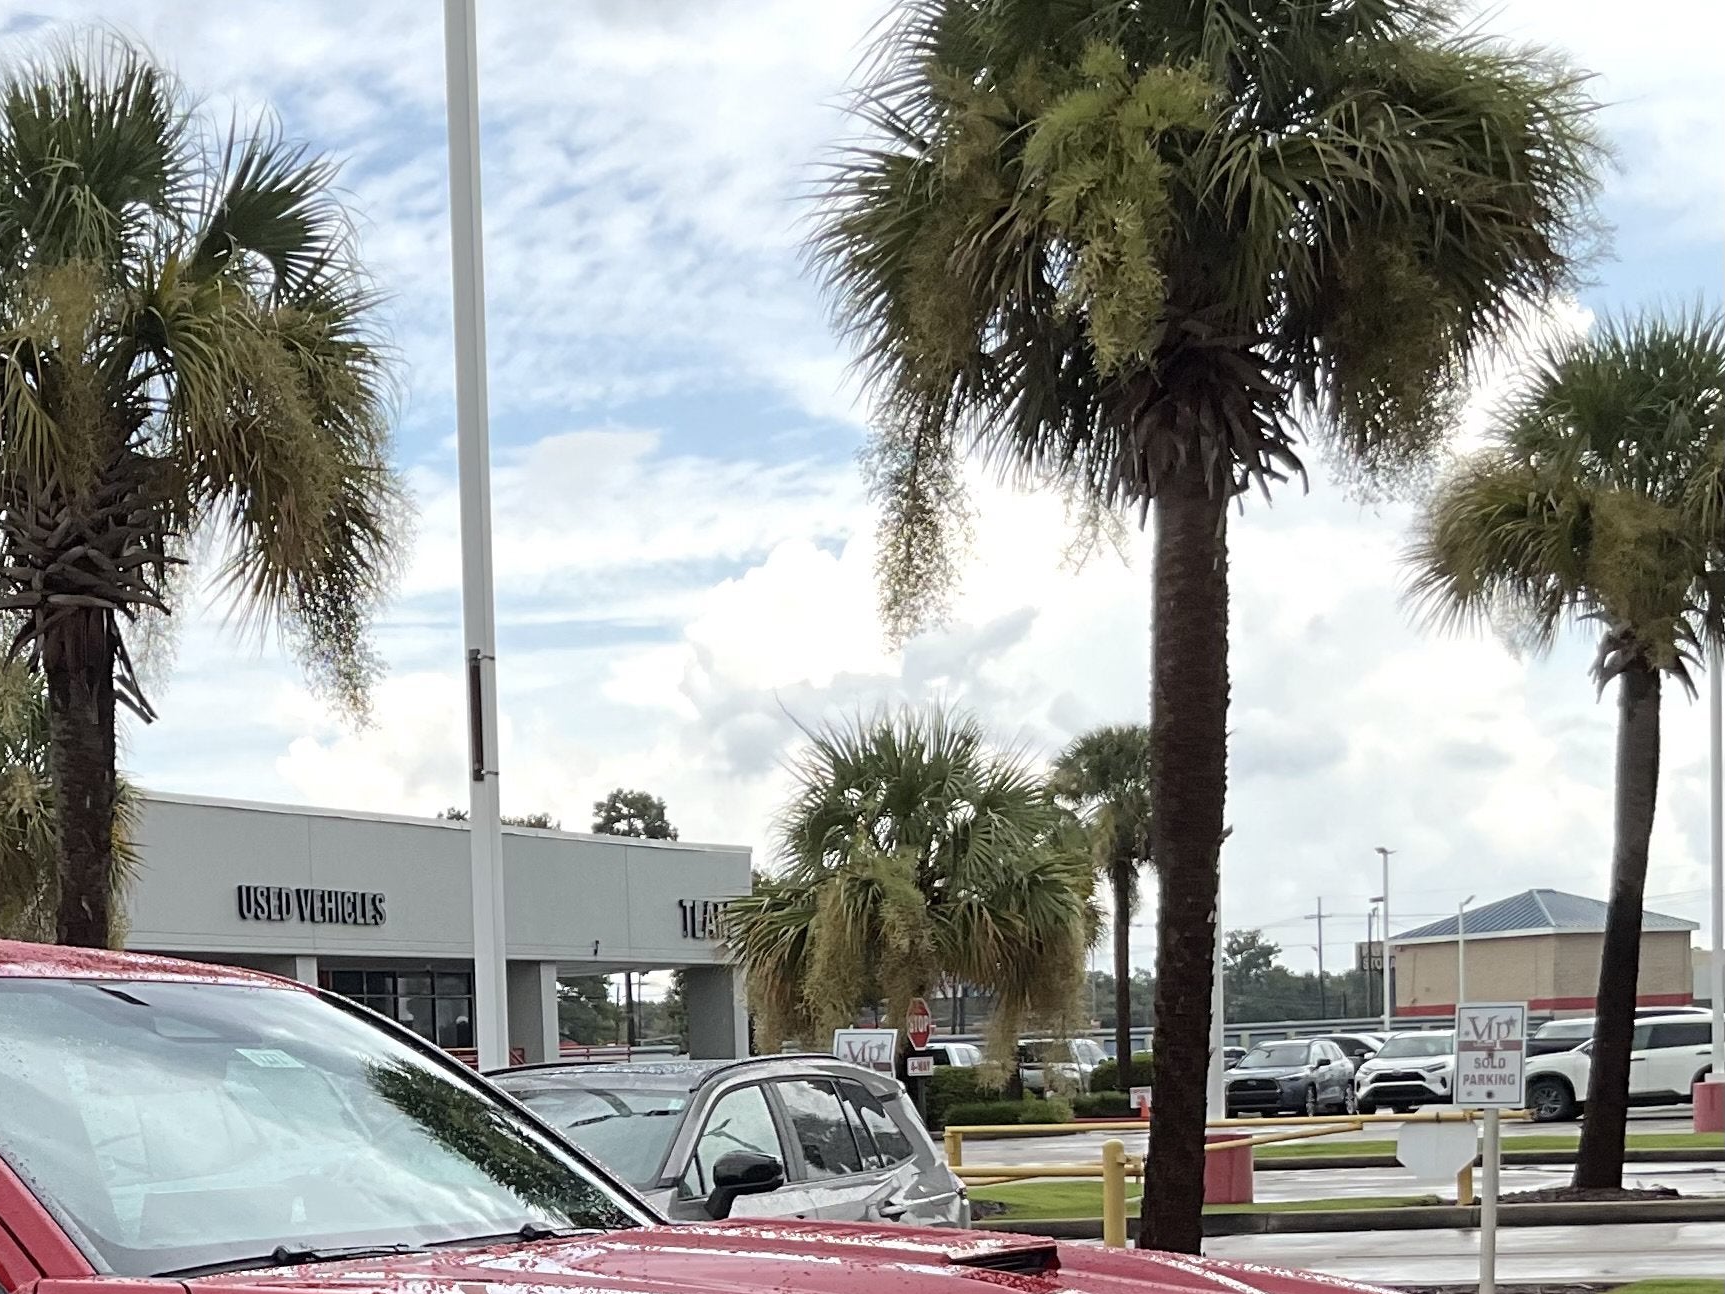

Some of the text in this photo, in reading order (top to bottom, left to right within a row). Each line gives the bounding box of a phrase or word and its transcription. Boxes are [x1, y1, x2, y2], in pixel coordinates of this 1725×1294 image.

[237, 884, 387, 925] USED VEHICLES
[908, 1015, 928, 1033] STOP
[910, 1061, 931, 1073] 4-WAY
[1474, 1057, 1506, 1069] SOLD
[1463, 1073, 1516, 1086] PARKING
